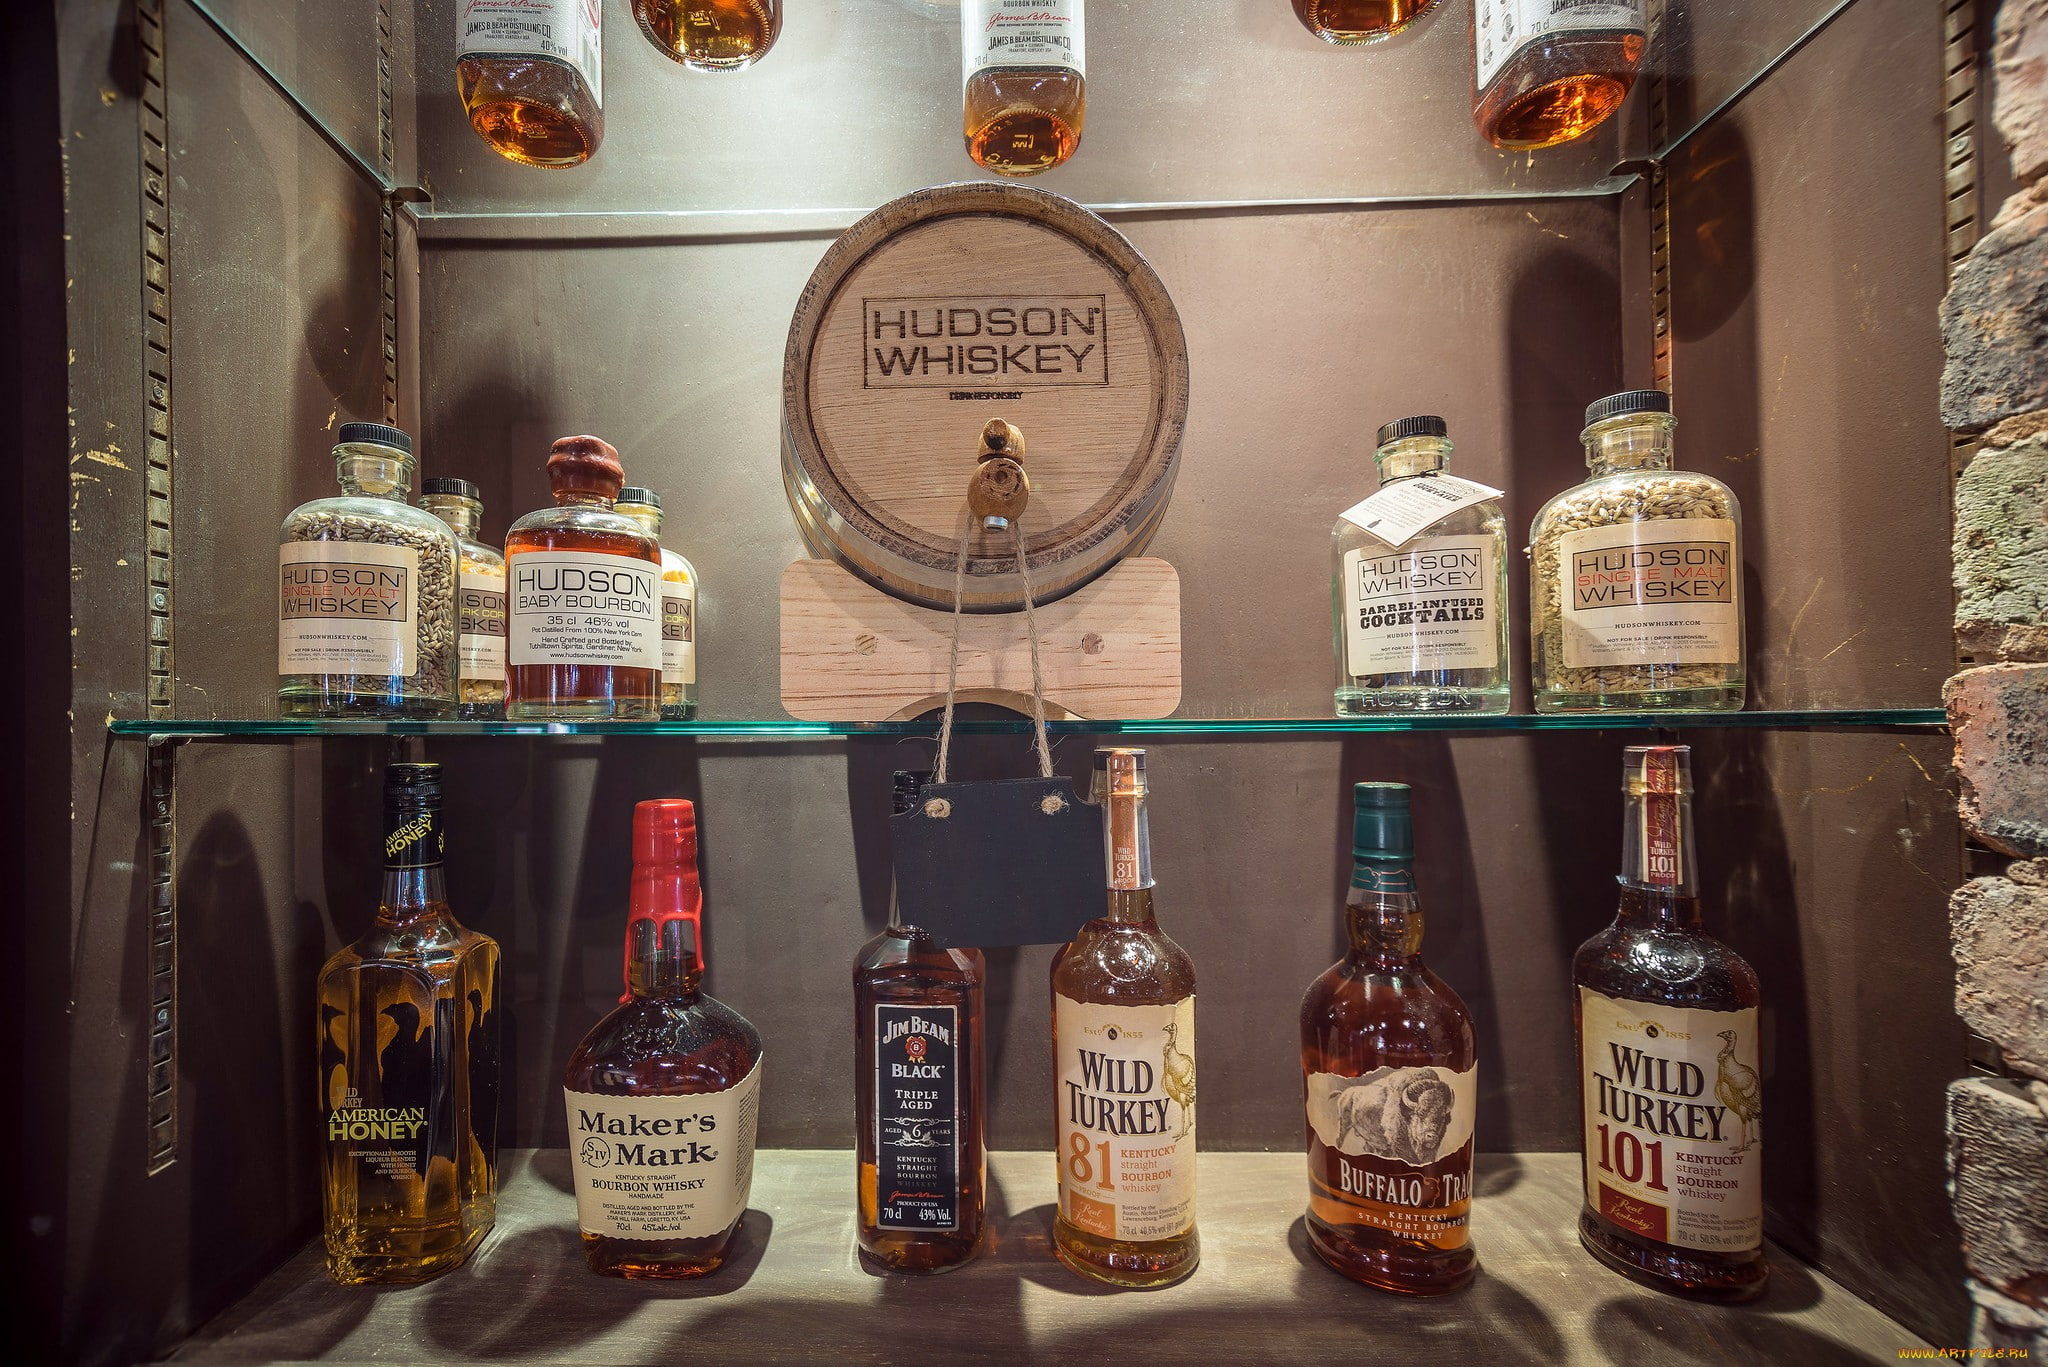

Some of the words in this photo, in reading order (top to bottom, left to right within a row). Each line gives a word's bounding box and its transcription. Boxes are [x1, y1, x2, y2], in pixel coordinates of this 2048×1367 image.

[465, 22, 486, 36] JAMES
[492, 22, 509, 30] BEAM
[510, 22, 541, 35] DISTILLING
[1531, 21, 1541, 35] 70
[1543, 19, 1549, 30] cl
[541, 40, 557, 52] 40%
[558, 46, 568, 56] vol
[988, 36, 1008, 50] JAMES
[1032, 36, 1062, 46] DISTILLING
[874, 307, 1096, 339] HUDSON
[874, 344, 1095, 377] WHISKEY
[1362, 553, 1477, 579] HUDSON
[1579, 549, 1727, 574] HUDSON
[283, 569, 400, 588] HUDSON
[519, 568, 652, 599] HUDSON
[1363, 571, 1478, 594] WHISKEY
[1578, 568, 1661, 587] SINGLE
[1674, 567, 1726, 579] MALT
[283, 585, 333, 598] SINGLE
[343, 586, 400, 599] MALT
[283, 598, 399, 615] WHISKEY
[520, 595, 561, 609] BABY
[566, 595, 651, 615] BOURBON
[1359, 598, 1484, 616] BARREL-INFUSED
[547, 616, 563, 625] 35
[567, 616, 577, 625] cl
[585, 617, 612, 627] 46%
[615, 620, 630, 628] vol
[665, 615, 690, 625] CORN
[1359, 607, 1485, 630] COCKTAILS
[1615, 620, 1701, 629] HUDSONWHISKEY.COM
[550, 652, 623, 660] www.hudsonwhiskey.com
[386, 820, 432, 857] HONEY
[1654, 840, 1671, 848] WILD
[1116, 862, 1133, 878] 81
[1650, 856, 1676, 873] 101
[1665, 1031, 1692, 1041] 1855
[891, 1063, 941, 1078] BLACK
[1079, 1049, 1154, 1094] WILD
[1609, 1041, 1705, 1097] WILD
[895, 1090, 938, 1099] TRIPLE
[900, 1100, 933, 1110] AGED
[1066, 1080, 1170, 1136] TURKEY
[1593, 1072, 1727, 1141] TURKEY
[329, 1107, 425, 1123] AMERICAN
[578, 1109, 716, 1137] Maker's
[329, 1121, 423, 1141] HONEY
[912, 1124, 921, 1137] 6
[615, 1142, 717, 1167] Mark
[1121, 1145, 1176, 1158] KENTUCKY
[1597, 1124, 1668, 1192] 101
[1676, 1152, 1744, 1165] KENTUCKY
[1070, 1132, 1115, 1191] 81
[1121, 1160, 1158, 1171] straight
[1121, 1169, 1172, 1181] BOURBON
[1676, 1164, 1722, 1177] straight
[592, 1179, 649, 1191] BOURBON
[652, 1179, 705, 1192] WHISKY
[1122, 1184, 1161, 1193] whiskey
[1339, 1158, 1422, 1206] BUFFALO
[1677, 1176, 1739, 1189] BOURBON
[1677, 1187, 1726, 1202] whiskey
[884, 1207, 894, 1219] 70
[895, 1207, 902, 1219] cl
[919, 1208, 936, 1220] 43%
[936, 1208, 951, 1220] Vol.
[1080, 1202, 1102, 1218] Real
[1616, 1196, 1643, 1215] Real
[1073, 1210, 1111, 1232] Kentucky
[1358, 1212, 1418, 1231] STRAIGHT
[1426, 1217, 1465, 1231] BOURBON
[1389, 1211, 1448, 1222] KENTUCKY
[1606, 1204, 1655, 1230] Kentucky
[1123, 1226, 1130, 1235] 70
[1131, 1227, 1137, 1235] cl
[1392, 1230, 1443, 1239] WHISKEY
[1678, 1230, 1687, 1240] 70
[1689, 1232, 1696, 1241] cl
